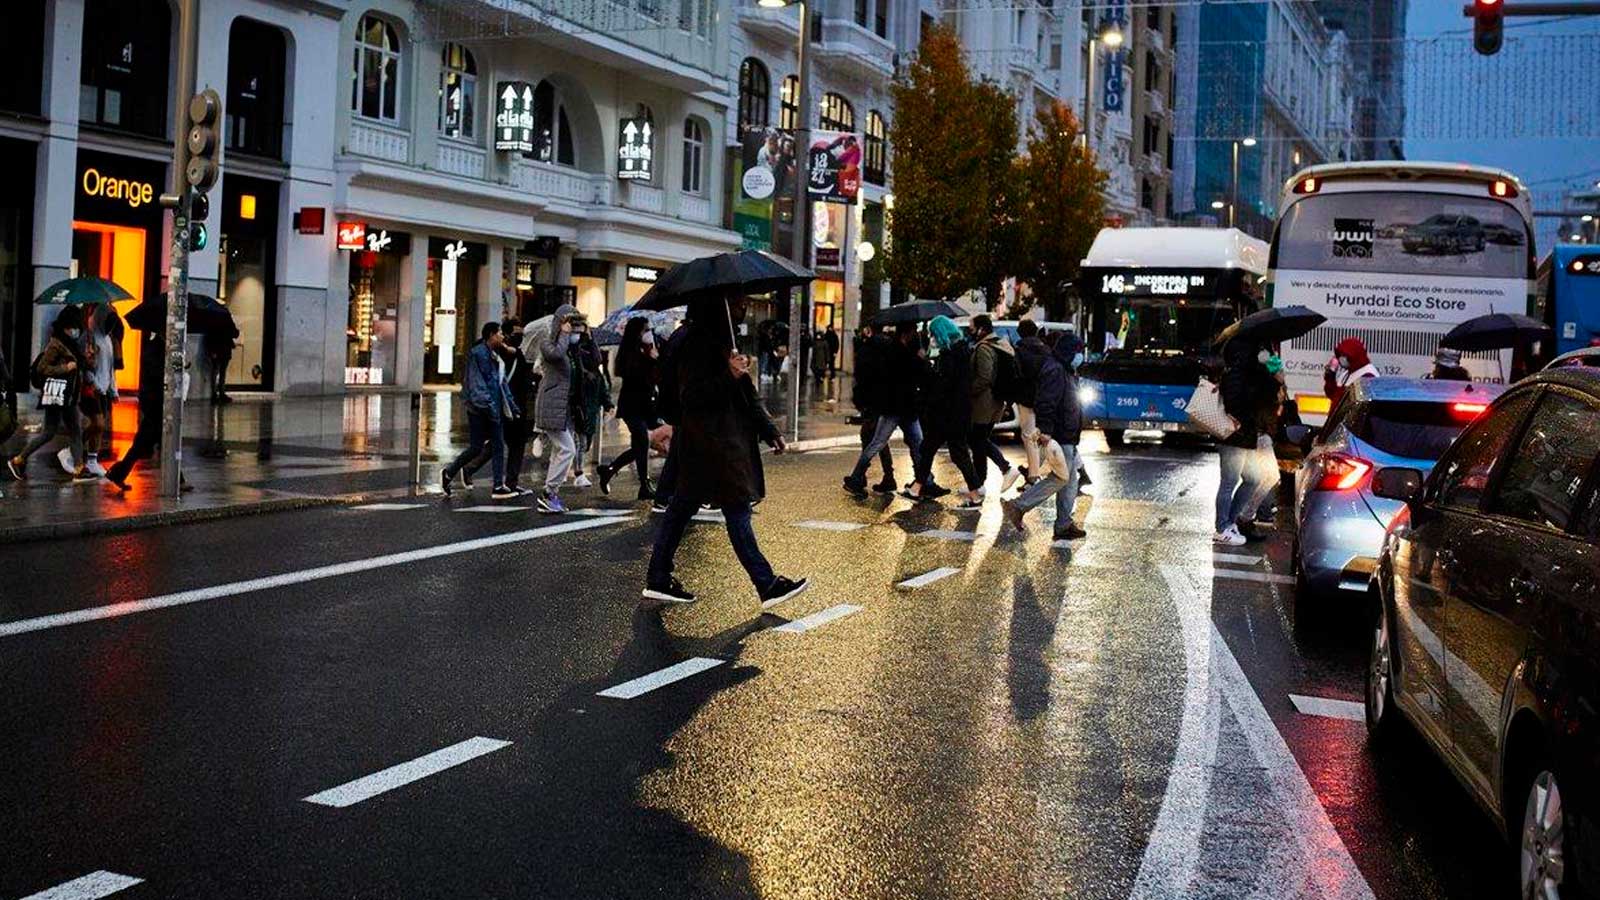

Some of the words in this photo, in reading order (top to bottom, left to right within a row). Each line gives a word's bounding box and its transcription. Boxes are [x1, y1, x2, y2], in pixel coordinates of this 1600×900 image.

[83, 168, 153, 208] Orange
[1102, 275, 1125, 293] 146
[1190, 276, 1204, 286] EN
[1291, 280, 1306, 288] Ven
[1313, 281, 1351, 290] descubre
[1391, 285, 1430, 294] concepto
[1326, 293, 1391, 308] Hyundai
[1393, 295, 1422, 309] Eco
[1425, 296, 1466, 311] Store
[1354, 309, 1366, 317] de
[1367, 310, 1394, 318] Motor
[1395, 310, 1436, 320] Gamboa
[1116, 396, 1140, 407] 2169
